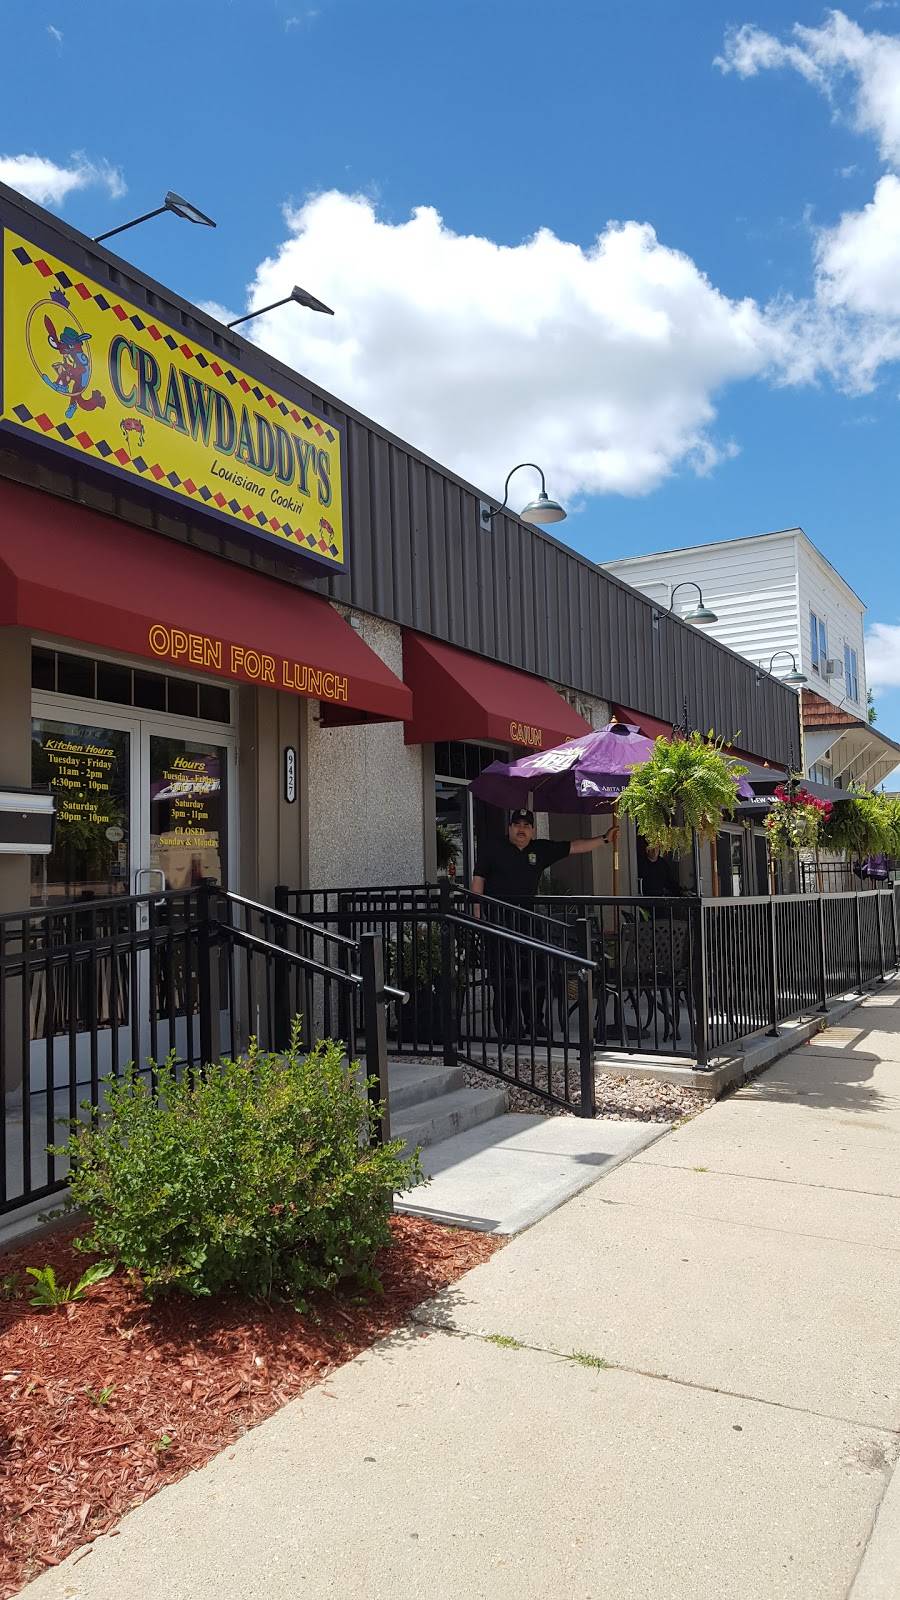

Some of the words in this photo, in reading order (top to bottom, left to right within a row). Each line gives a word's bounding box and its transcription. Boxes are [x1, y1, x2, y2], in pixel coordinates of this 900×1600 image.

[108, 334, 333, 508] CRAWDADDY'S
[210, 459, 266, 497] Louisiana
[149, 624, 222, 669] OPEN
[231, 645, 276, 683] FOR
[283, 660, 348, 701] LUNCH
[509, 721, 542, 747] CAJUN
[46, 739, 83, 752] Kitchen
[85, 744, 115, 756] Hours
[48, 753, 81, 767] Tuesday
[87, 758, 112, 771] Friday
[173, 756, 206, 771] Hours
[59, 766, 79, 776] 11am
[86, 769, 103, 779] 2pm
[162, 770, 189, 782] Tuesday
[51, 777, 81, 790] 4:30pm
[88, 780, 109, 791] 10pm
[63, 800, 99, 813] Saturday
[174, 798, 205, 810] Saturday
[56, 811, 81, 823] :30pm
[88, 813, 109, 824] 10pm
[171, 809, 186, 819] 3pm
[191, 810, 209, 820] 11pm
[174, 826, 205, 836] CLOSED
[159, 838, 184, 847] Sunday
